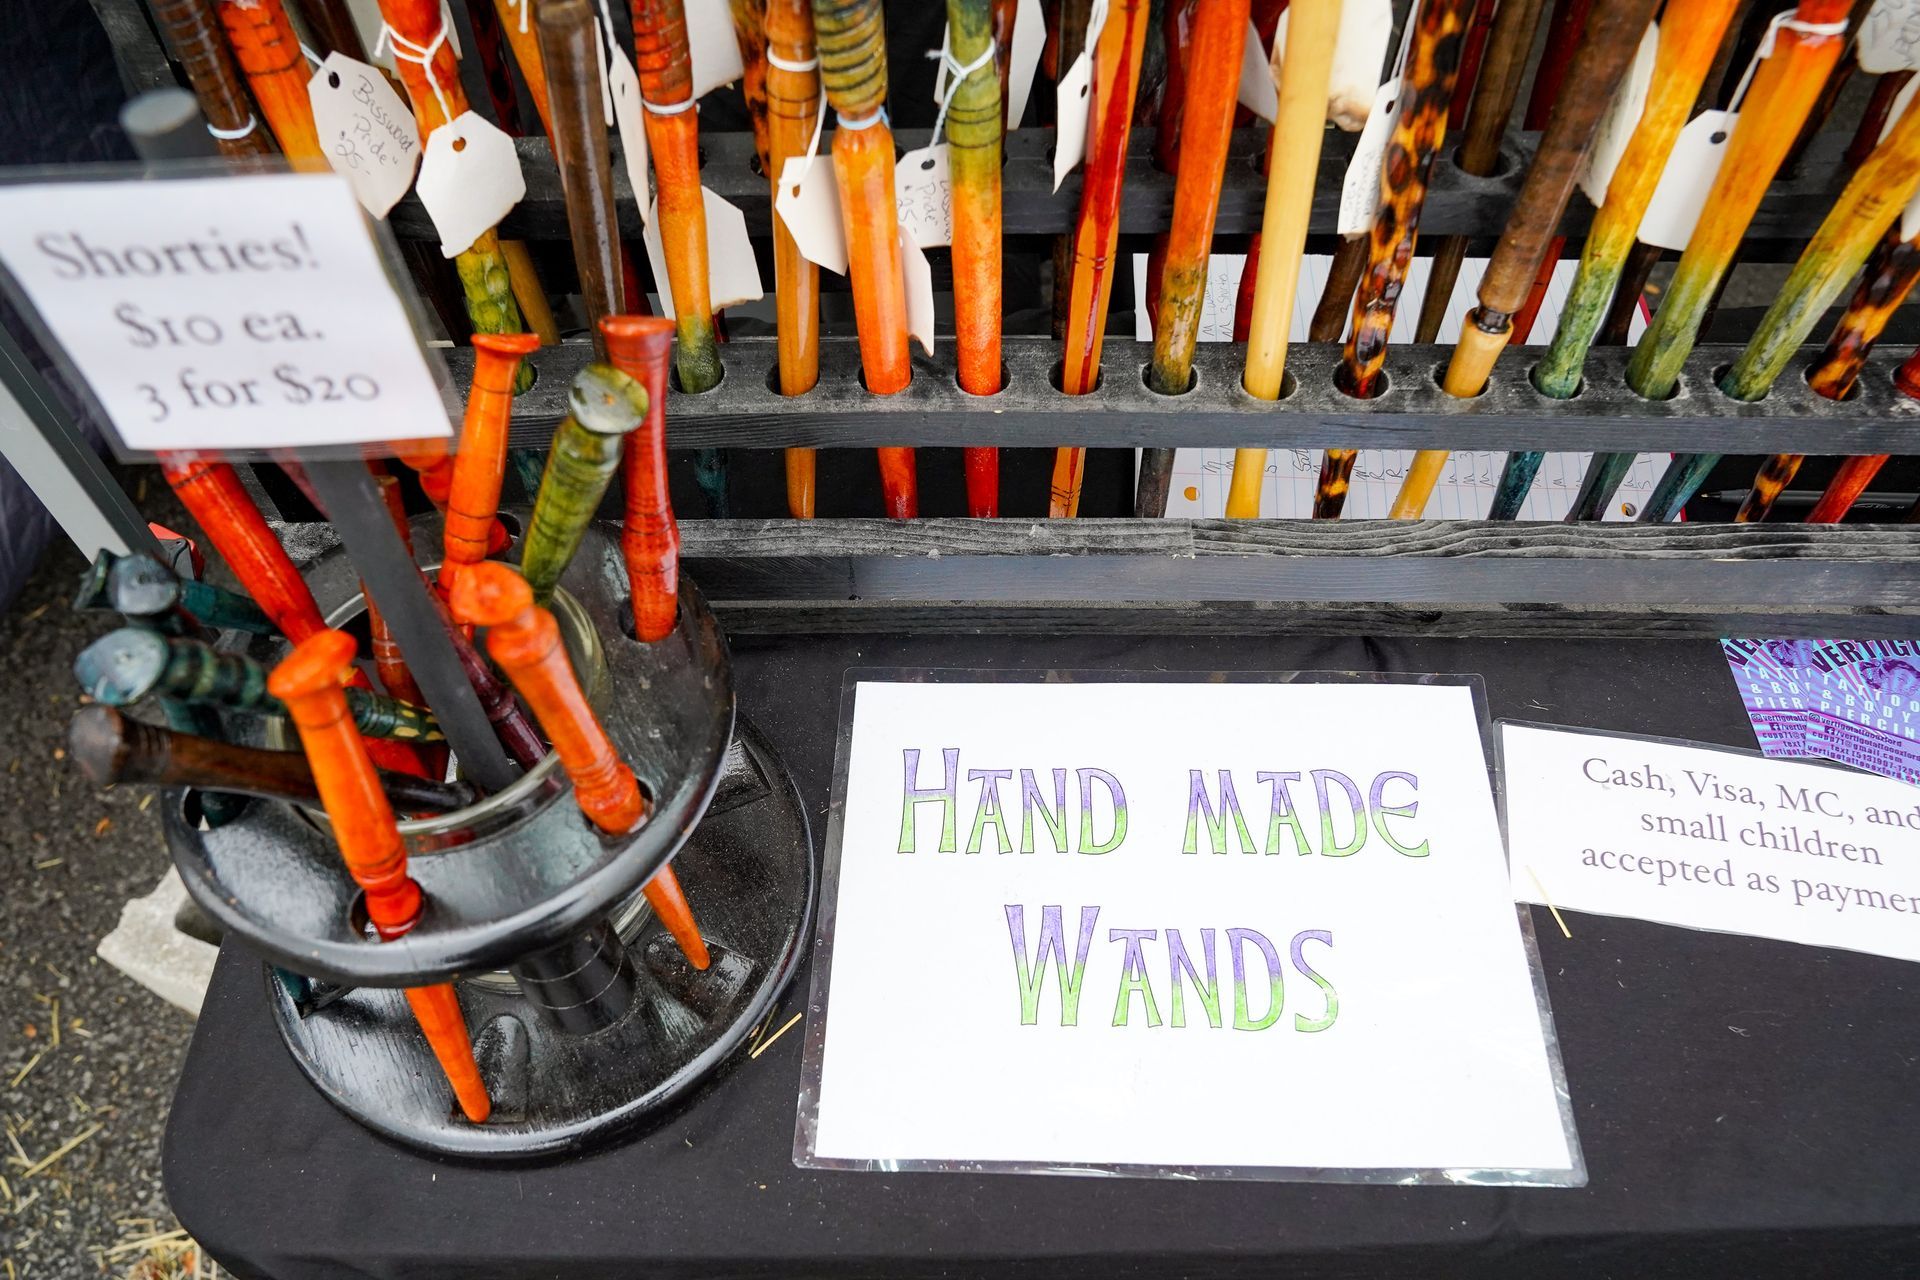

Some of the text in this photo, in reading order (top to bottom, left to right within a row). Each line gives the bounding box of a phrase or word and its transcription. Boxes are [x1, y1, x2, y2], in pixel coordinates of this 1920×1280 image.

[34, 221, 320, 282] Shorties!
[113, 301, 325, 350] $10 ea.
[136, 364, 382, 423] 3 for $20
[1845, 693, 1911, 724] BODY
[1582, 757, 1676, 797] Cash,
[1683, 769, 1766, 811] Visa,
[1776, 783, 1855, 825] MC,
[1640, 812, 1884, 866] small children
[1581, 847, 1736, 888] accepted
[1747, 871, 1780, 894] as
